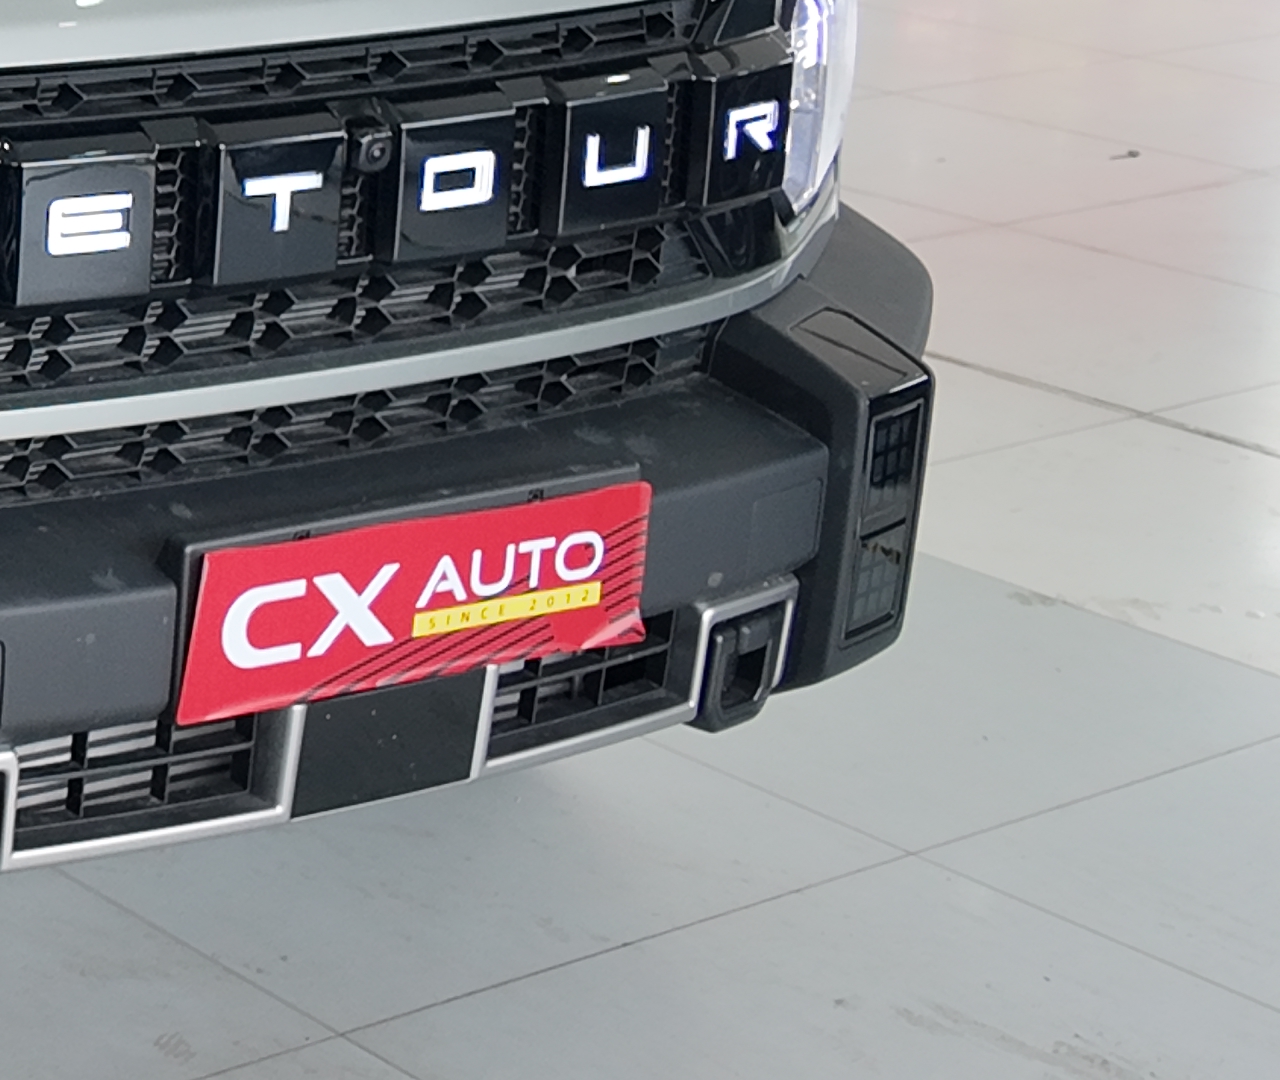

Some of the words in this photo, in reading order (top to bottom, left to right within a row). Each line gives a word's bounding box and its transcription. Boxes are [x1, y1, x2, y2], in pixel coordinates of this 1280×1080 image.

[220, 562, 401, 670] CX
[414, 529, 605, 609] AUTO
[427, 603, 507, 631] SINCE
[528, 587, 591, 612] 2012
